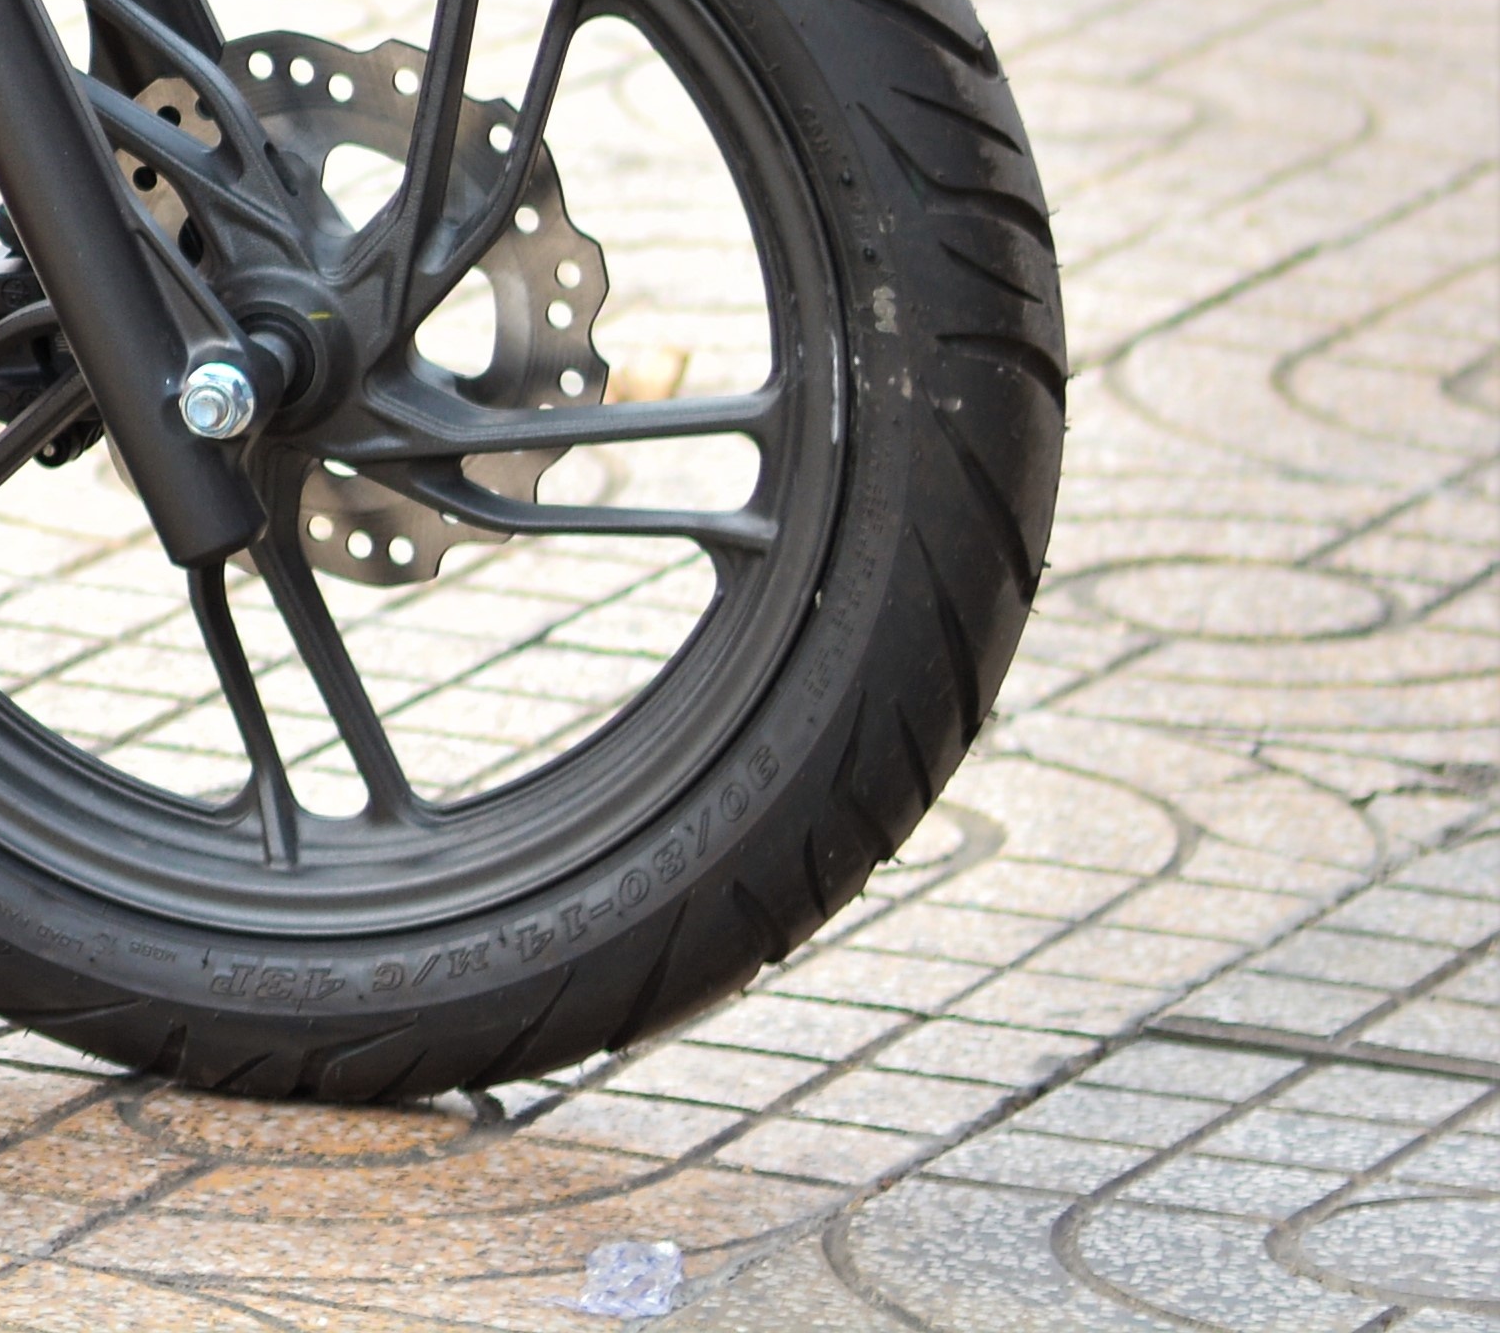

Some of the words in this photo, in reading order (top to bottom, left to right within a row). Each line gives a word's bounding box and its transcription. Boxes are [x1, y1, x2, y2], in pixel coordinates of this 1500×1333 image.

[514, 743, 782, 965] 90/80-14
[36, 924, 85, 954] LOAD
[208, 963, 347, 1003] 43P
[371, 942, 491, 994] M/C
